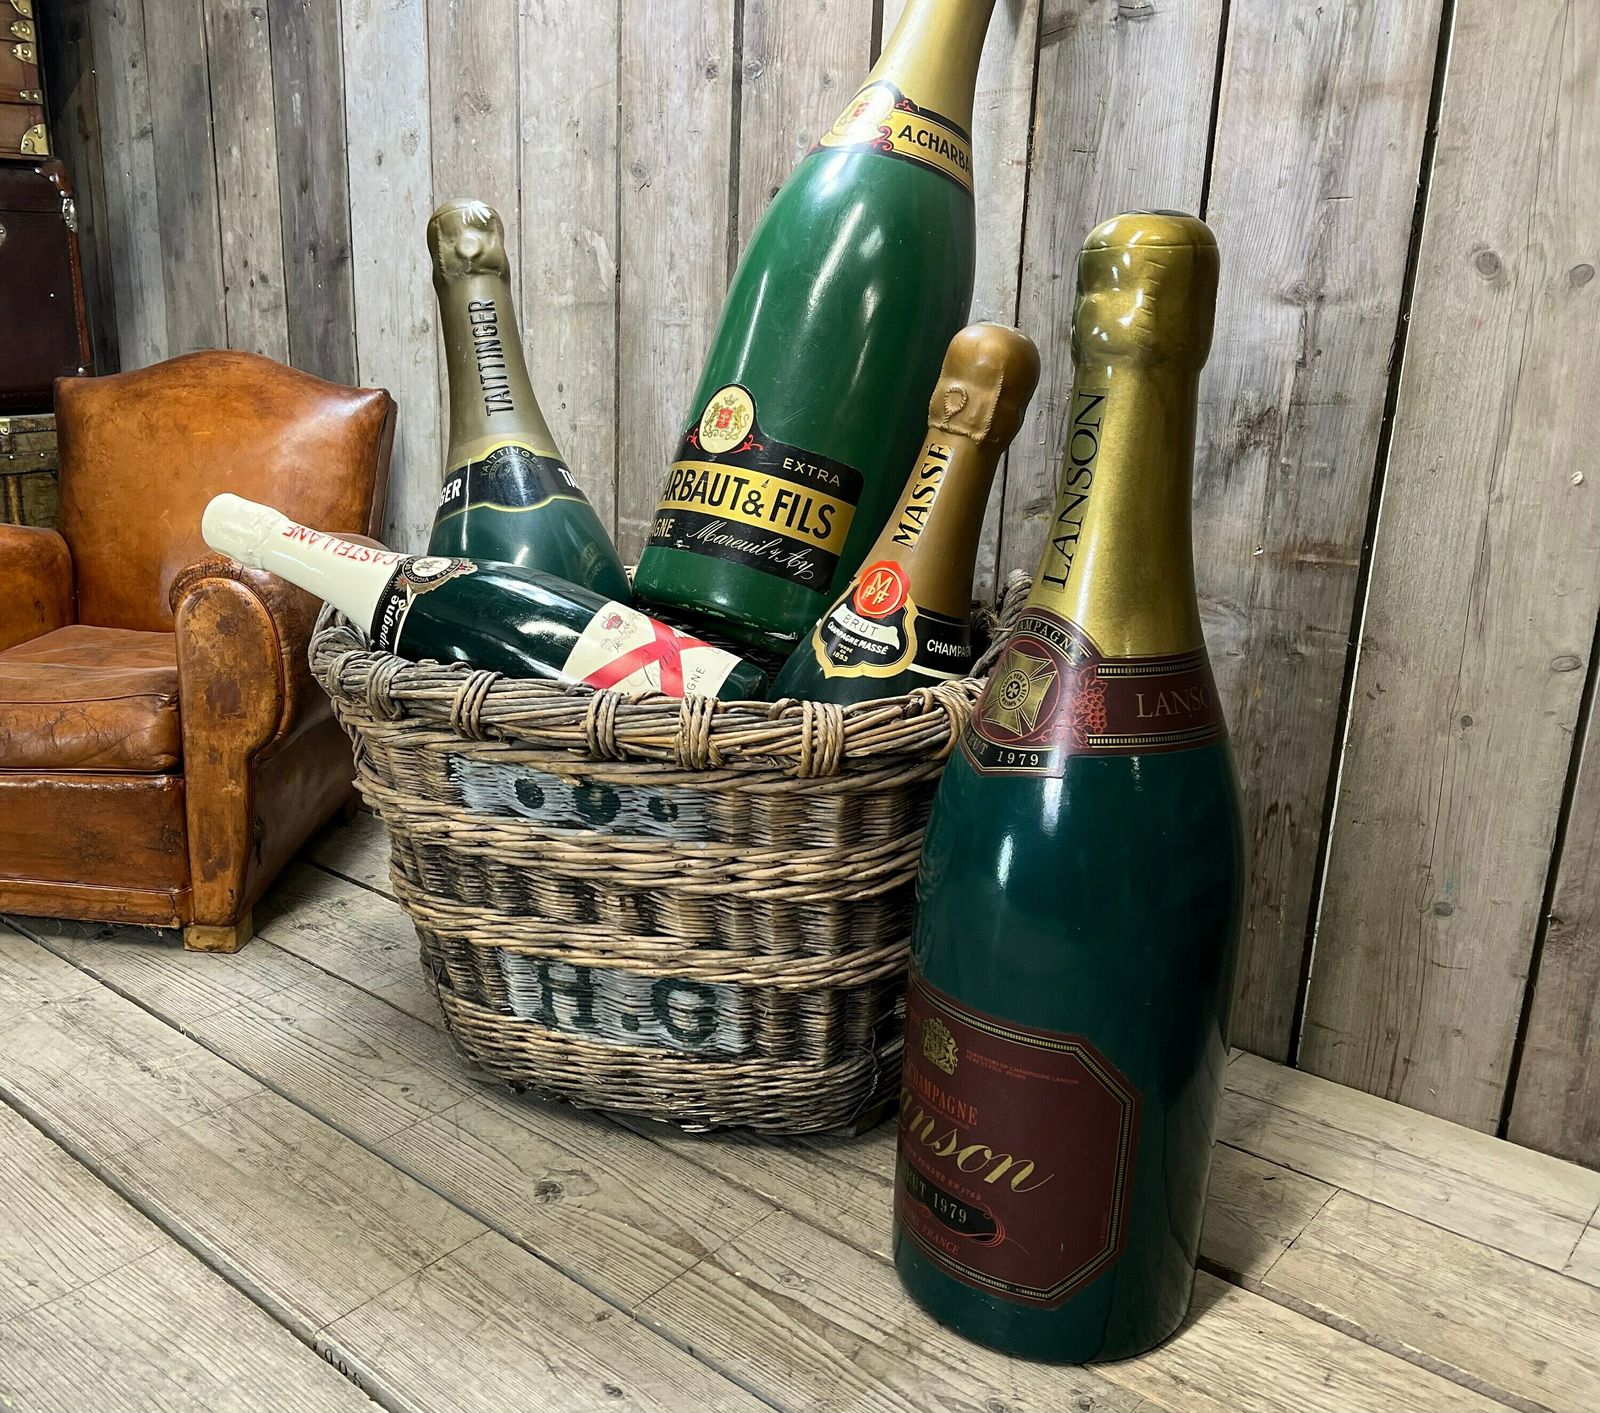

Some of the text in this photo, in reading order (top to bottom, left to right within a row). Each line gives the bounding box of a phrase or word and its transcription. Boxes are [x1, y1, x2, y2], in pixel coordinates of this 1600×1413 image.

[468, 299, 514, 417] TAITTINGER
[481, 446, 545, 477] TAITTINGER
[783, 457, 841, 487] EXTRA
[438, 478, 463, 508] GER
[1041, 390, 1106, 590] LANSON
[769, 488, 836, 540] FILS
[827, 621, 860, 648] CHAMPAGNE
[842, 613, 879, 637] BRUT
[686, 666, 706, 697] GNE
[997, 750, 1040, 767] 1979
[932, 1191, 968, 1224] 1979
